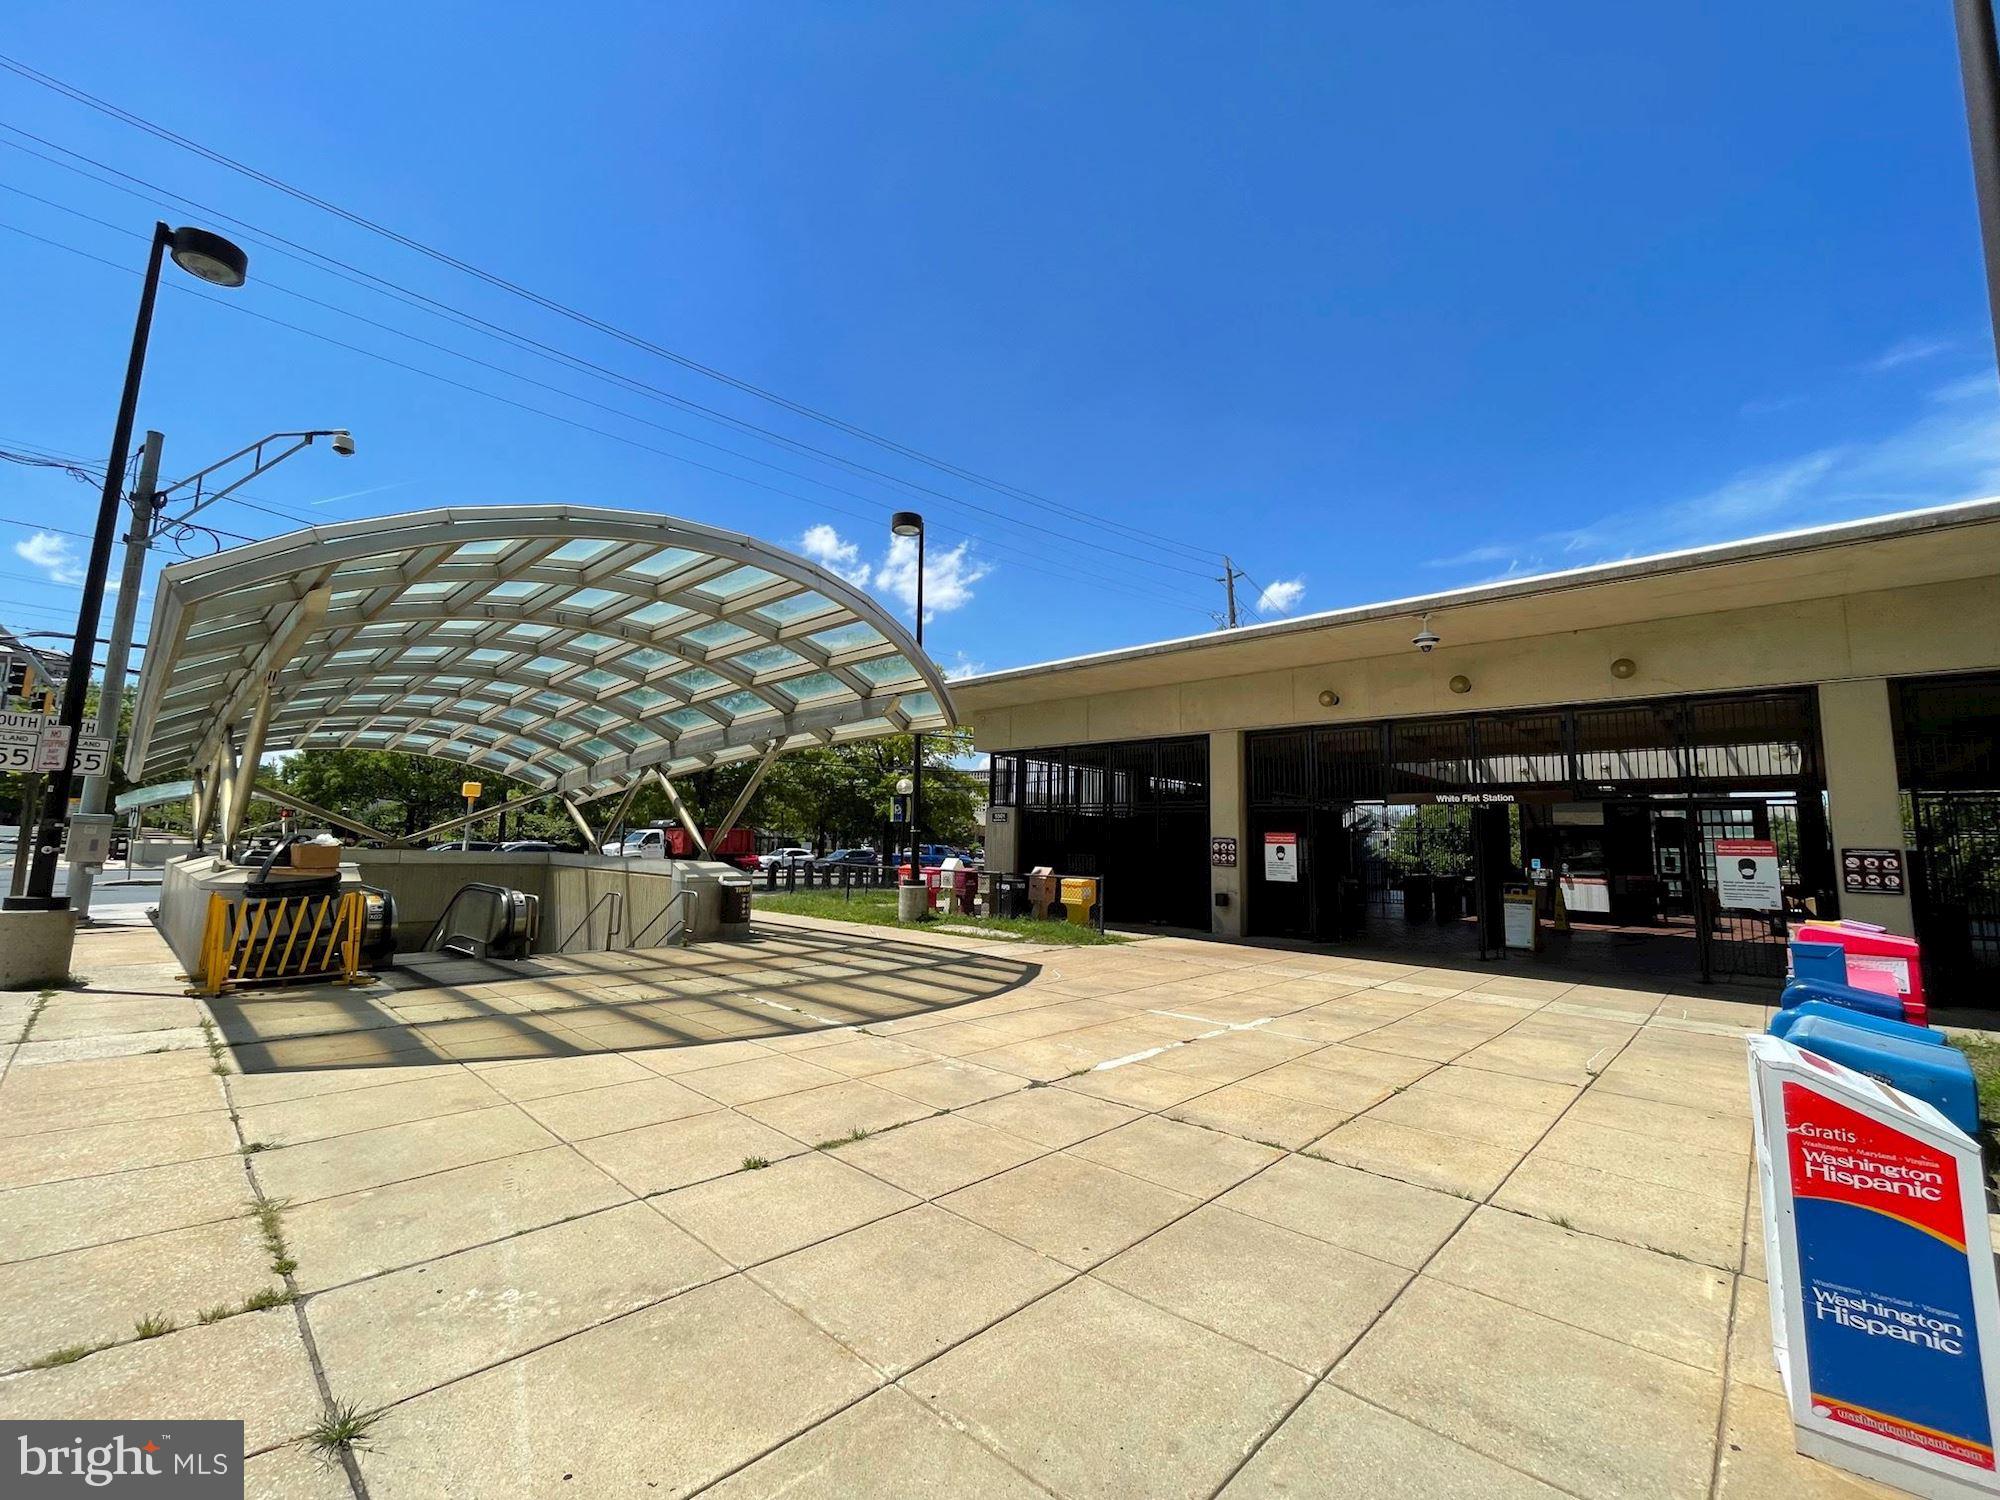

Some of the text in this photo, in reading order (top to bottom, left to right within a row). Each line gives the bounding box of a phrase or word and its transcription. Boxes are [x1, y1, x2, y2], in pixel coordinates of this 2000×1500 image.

[1436, 794, 1515, 803] White Flint Station
[1801, 1122, 1856, 1144] Gratis
[1802, 1140, 1849, 1153] Washington
[1856, 1149, 1897, 1161] Maryland
[1802, 1148, 1943, 1185] Washington
[1805, 1162, 1942, 1202] Hispanic
[1812, 1286, 1964, 1338] Washington
[1816, 1301, 1963, 1356] Hispanic
